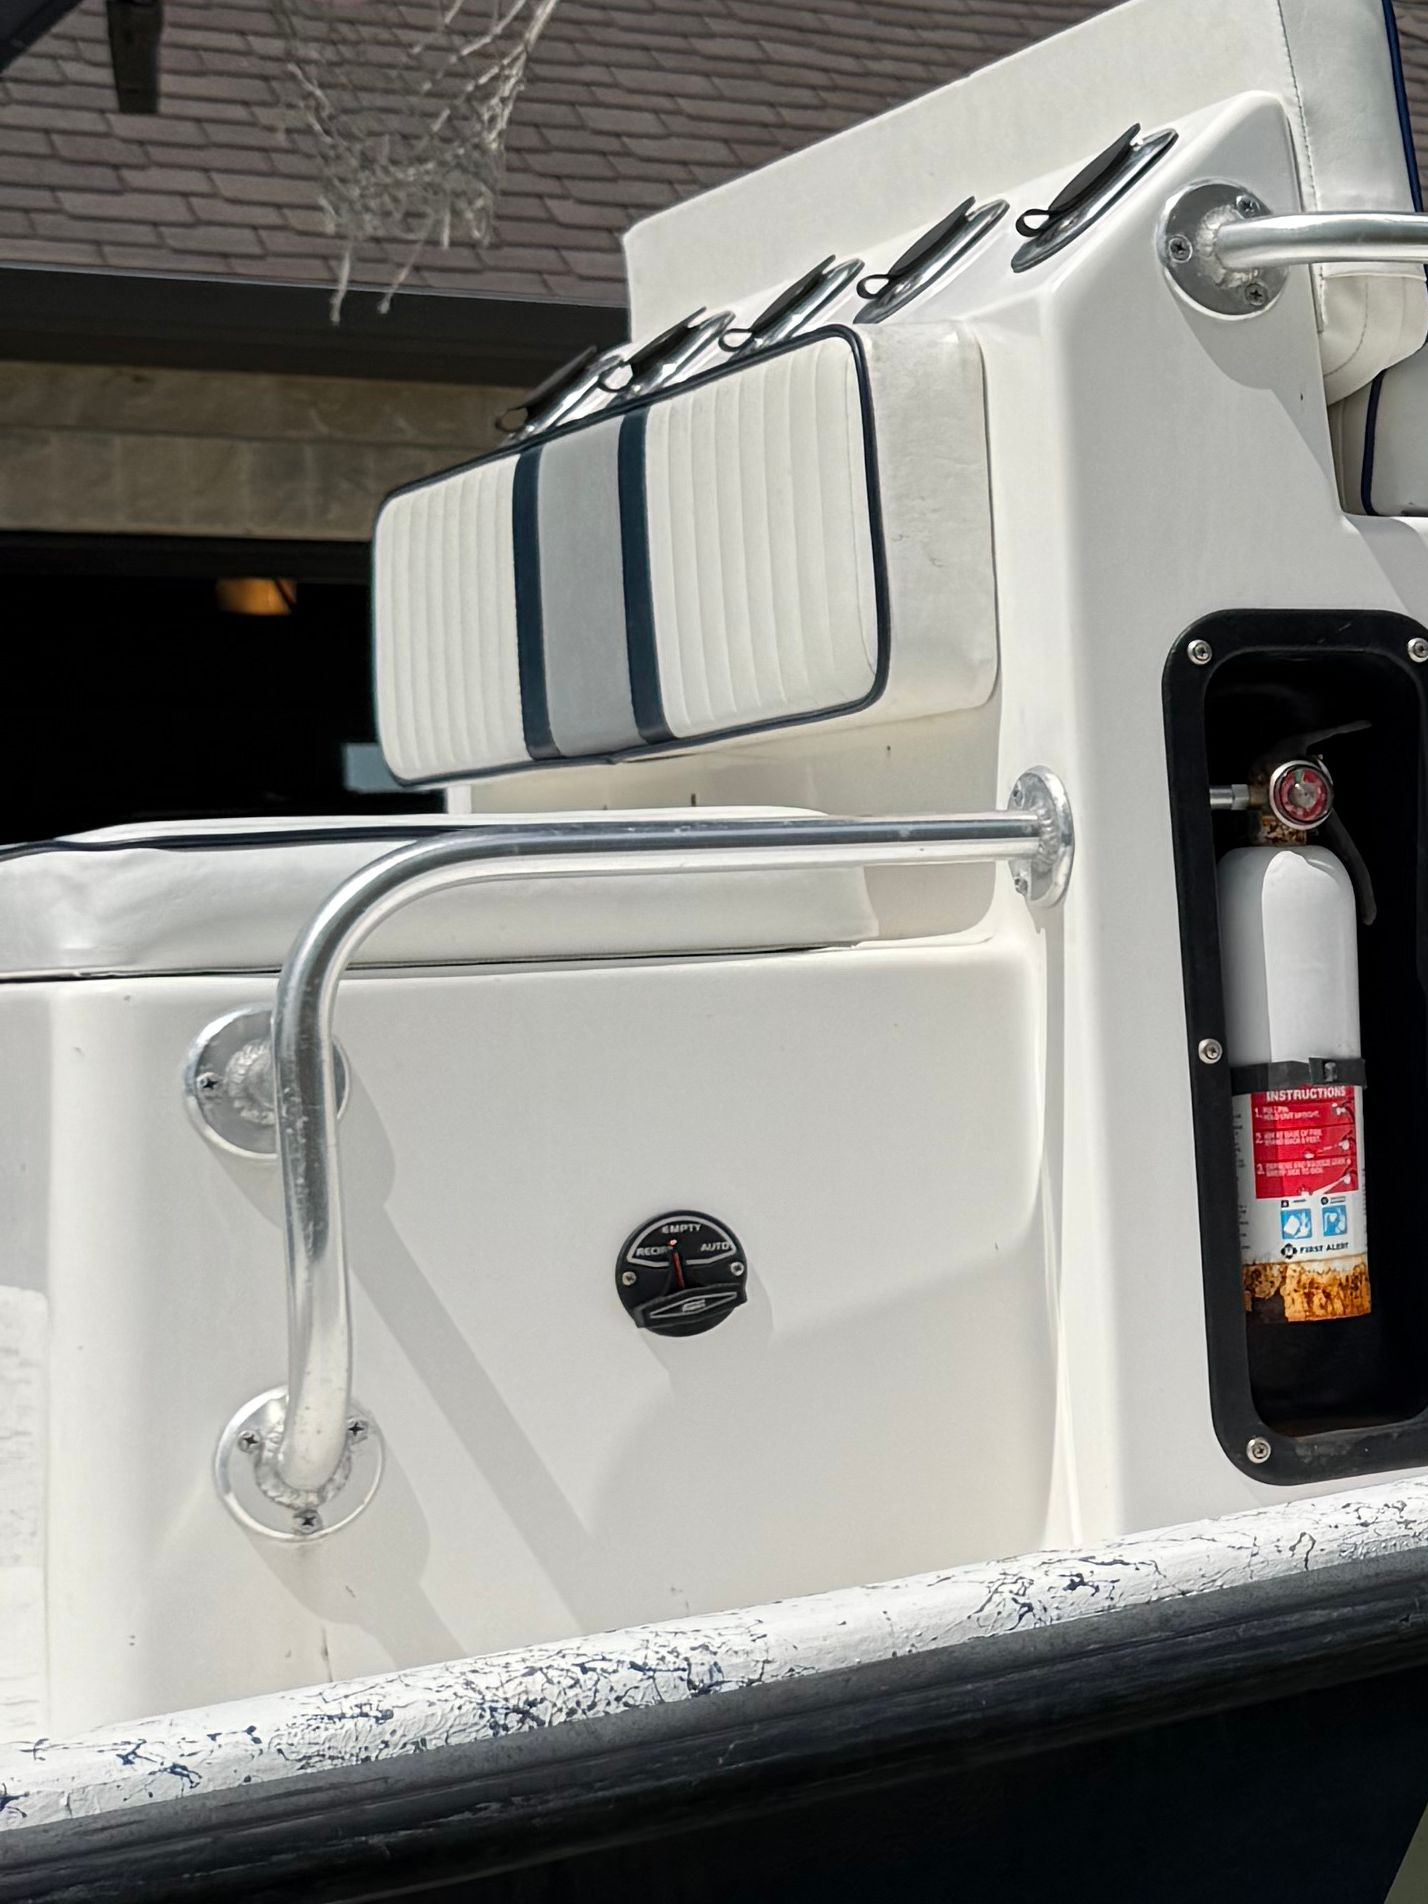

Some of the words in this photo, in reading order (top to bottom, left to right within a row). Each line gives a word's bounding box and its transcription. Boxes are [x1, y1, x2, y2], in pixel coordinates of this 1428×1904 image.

[1266, 1086, 1346, 1102] INSTRUCTIONS
[661, 1223, 702, 1233] EMPTY
[700, 1242, 730, 1251] AUTO
